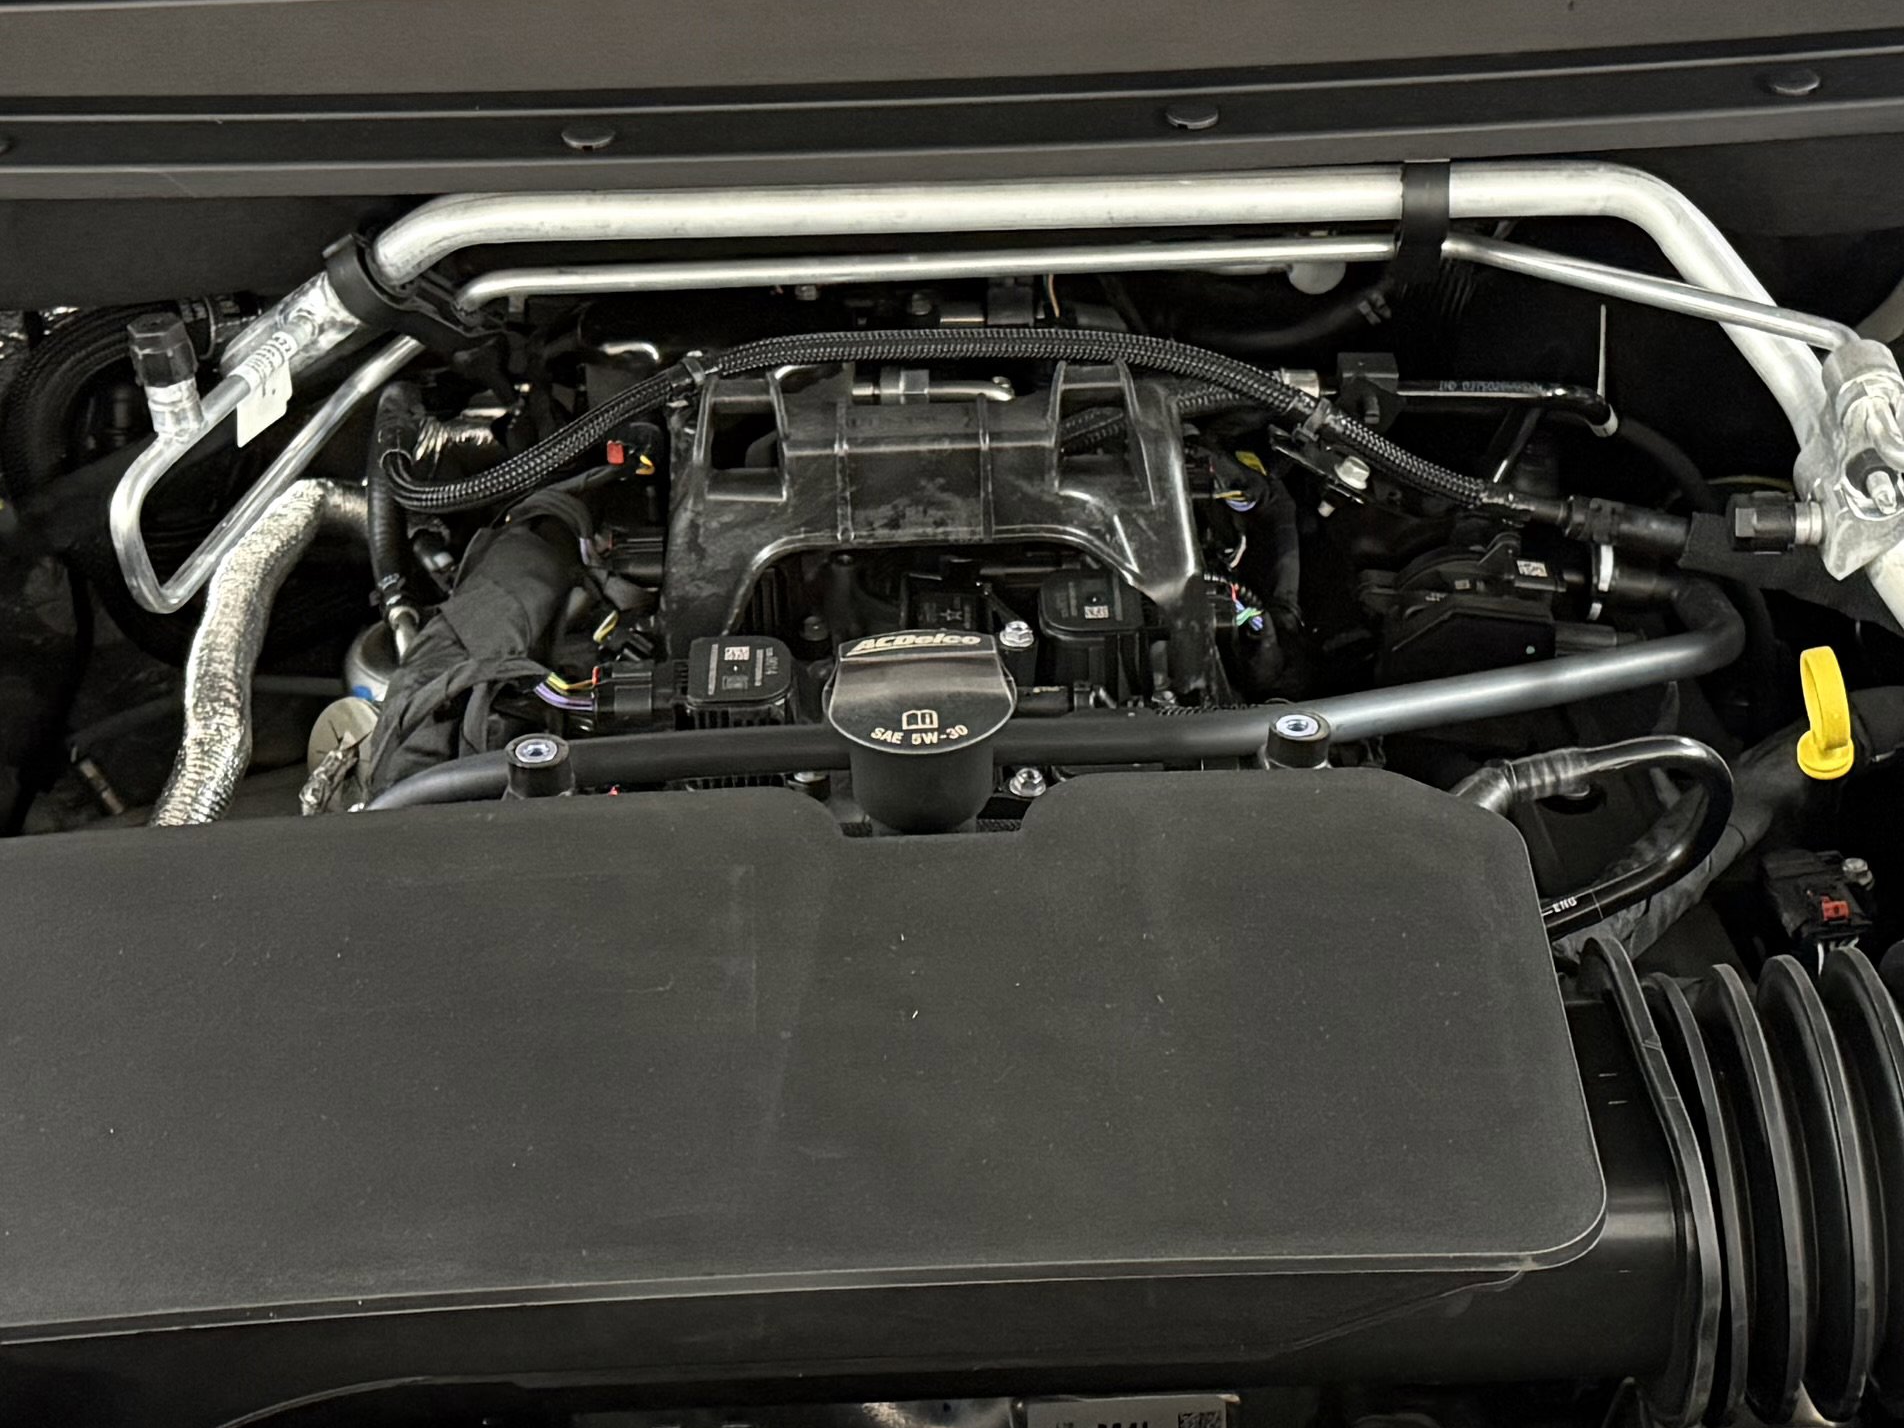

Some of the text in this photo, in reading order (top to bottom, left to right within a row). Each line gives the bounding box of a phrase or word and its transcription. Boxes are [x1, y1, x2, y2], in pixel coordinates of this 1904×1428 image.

[847, 632, 981, 656] ACDelco
[870, 724, 969, 745] SAE 5W-30
